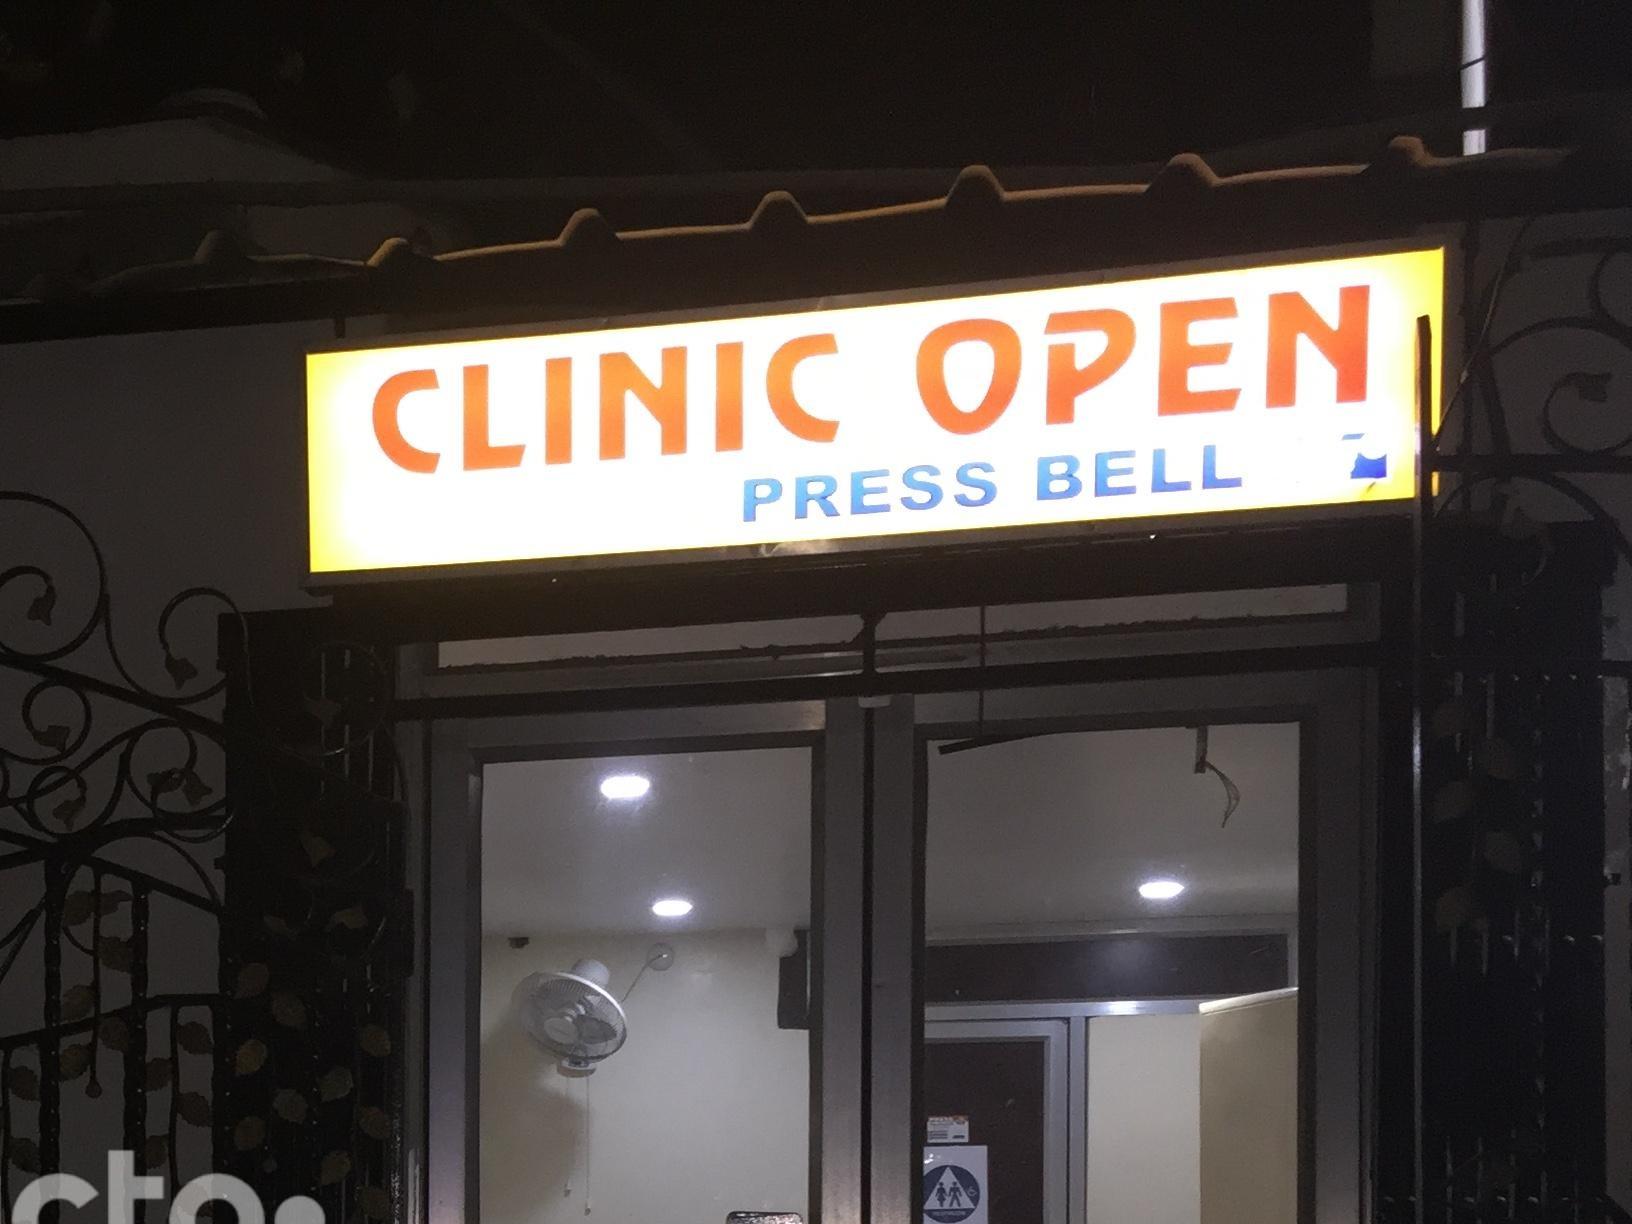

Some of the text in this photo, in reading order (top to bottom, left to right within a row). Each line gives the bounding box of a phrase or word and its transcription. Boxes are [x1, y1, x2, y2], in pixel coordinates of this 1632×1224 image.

[371, 285, 1370, 476] CLINIC OPEN
[741, 444, 1243, 523] PRESS BELL
